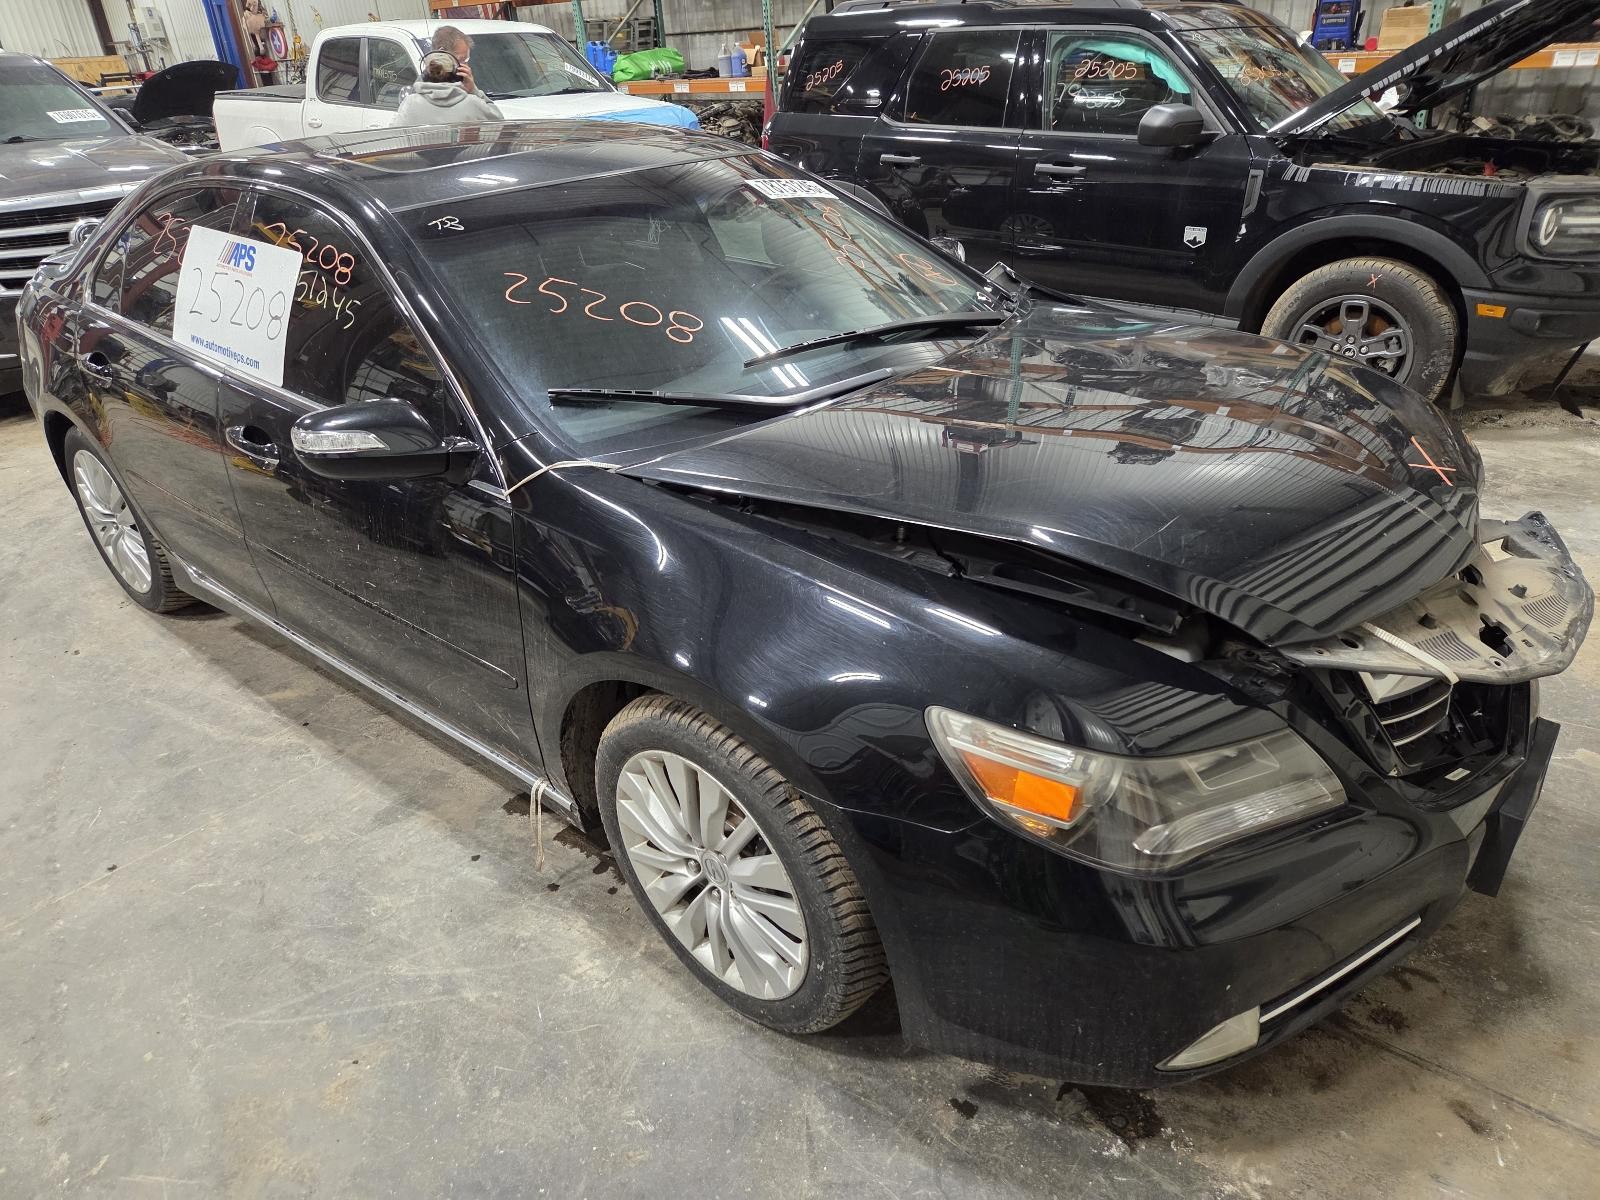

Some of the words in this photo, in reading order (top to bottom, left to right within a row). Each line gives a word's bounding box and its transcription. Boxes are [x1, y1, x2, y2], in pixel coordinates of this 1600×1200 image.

[805, 60, 844, 92] 25205
[940, 65, 991, 91] 25205
[1074, 59, 1137, 79] 25205
[227, 242, 257, 272] APS
[188, 266, 287, 341] 25208
[503, 272, 704, 343] 25208
[190, 333, 260, 370] www.automotiveps.com
